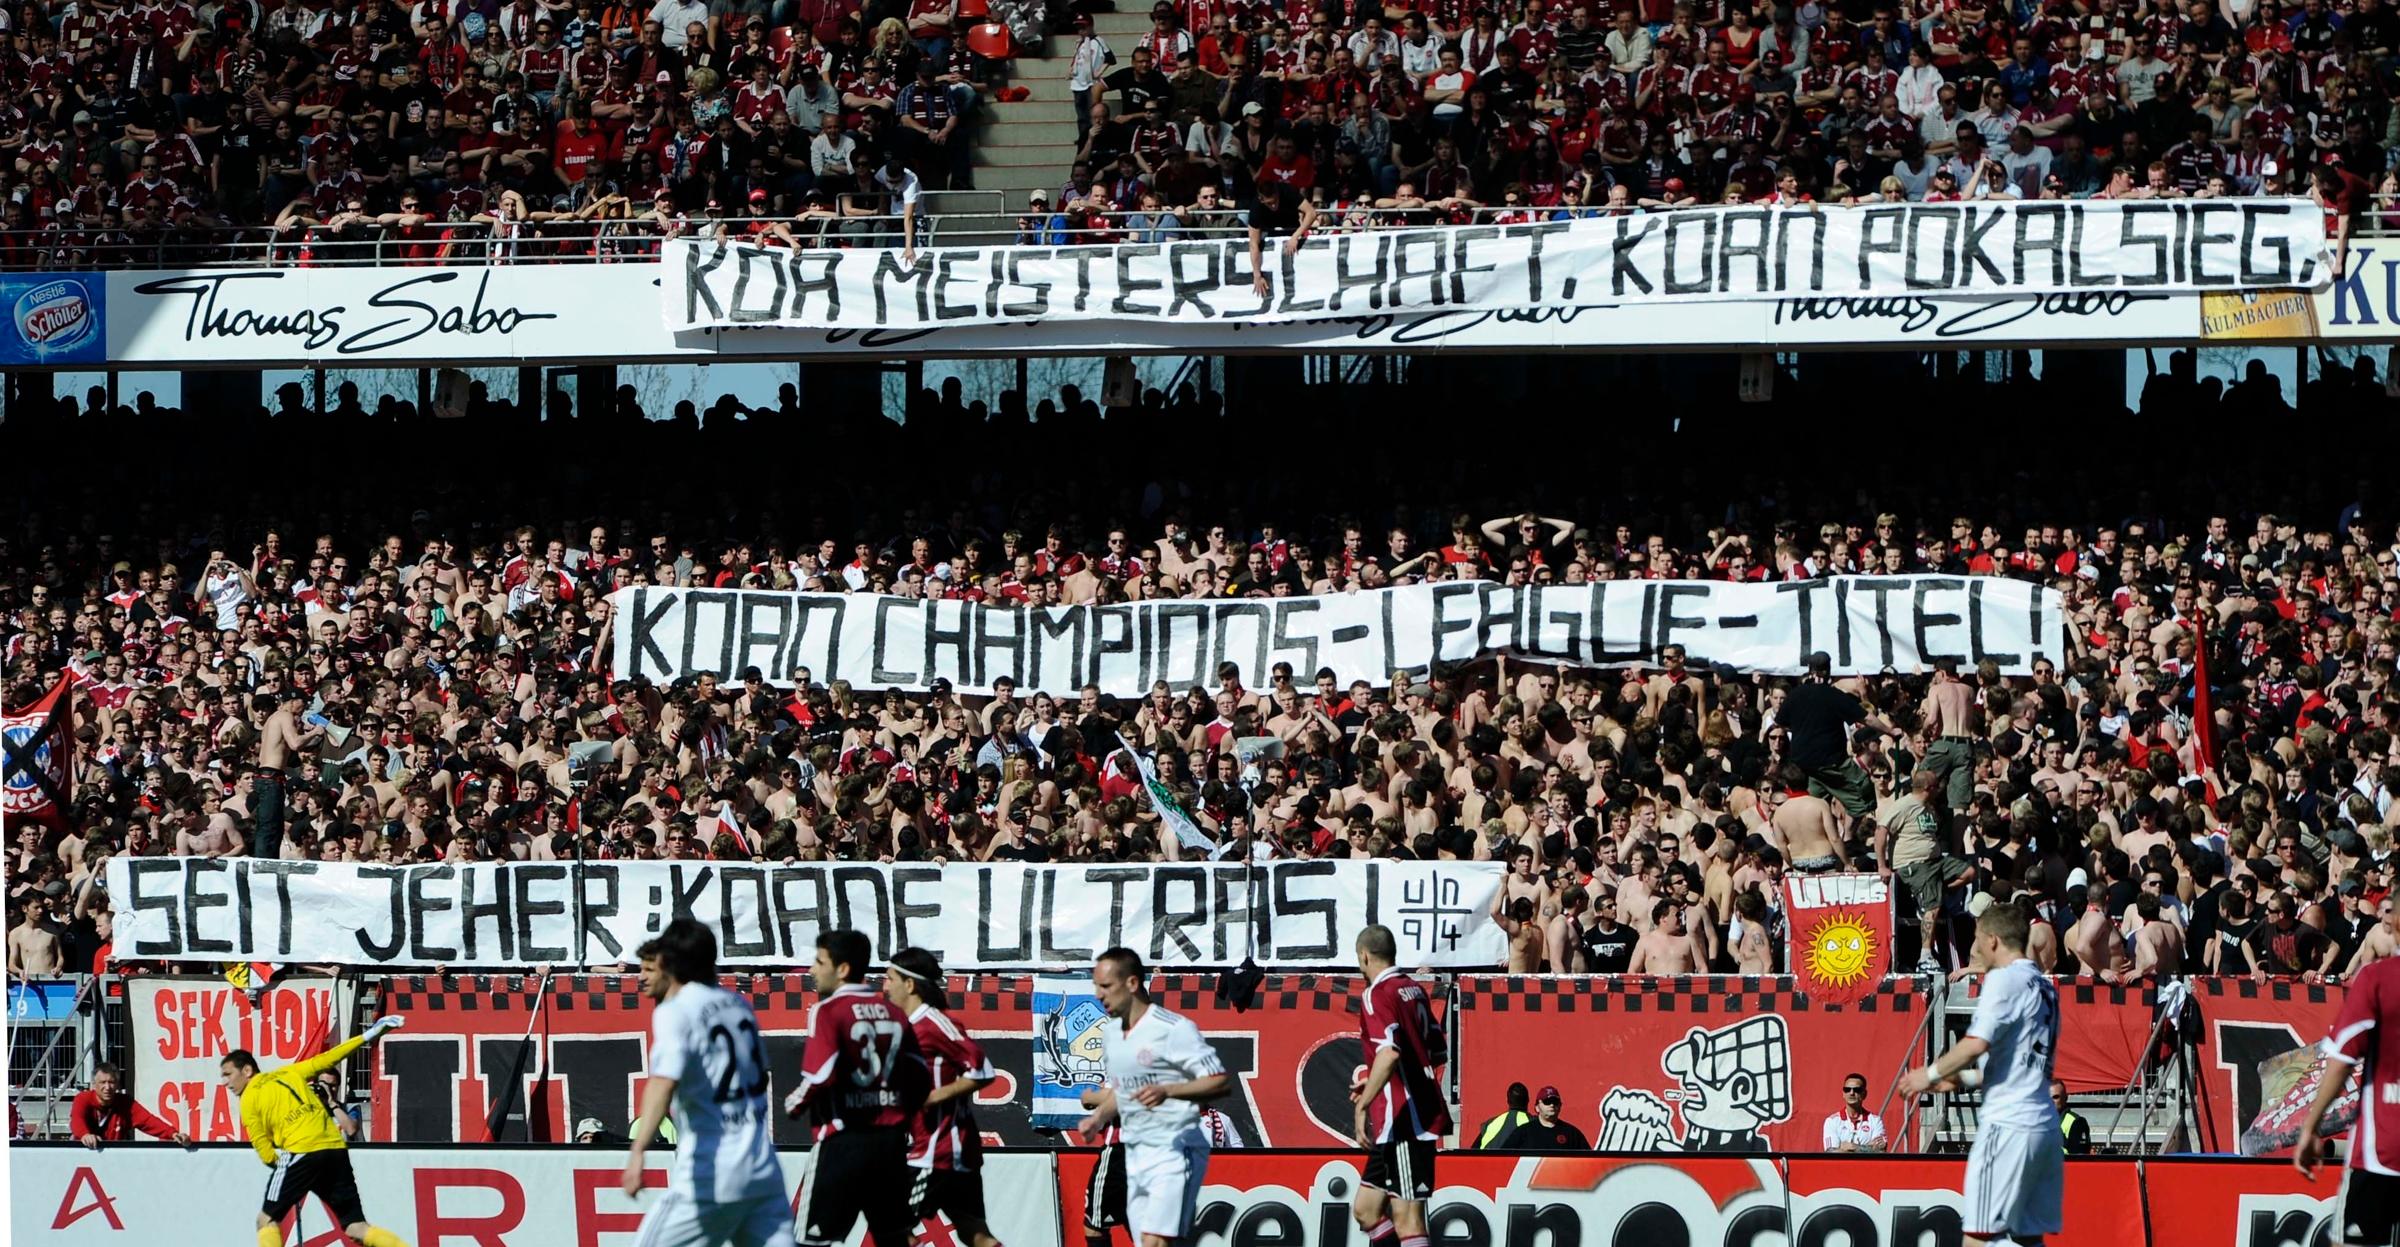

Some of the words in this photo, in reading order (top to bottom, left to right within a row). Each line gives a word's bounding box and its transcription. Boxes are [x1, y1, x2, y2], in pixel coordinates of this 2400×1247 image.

[27, 302, 83, 342] Schöller
[29, 284, 67, 306] Nestlé
[134, 272, 346, 348] Thomas
[337, 268, 557, 354] Sabo
[2201, 296, 2306, 336] KULMBACHER
[128, 858, 318, 954] SEIT
[154, 988, 331, 1061] SEKTION
[852, 1003, 890, 1020] EKICI
[850, 1020, 903, 1088] 37
